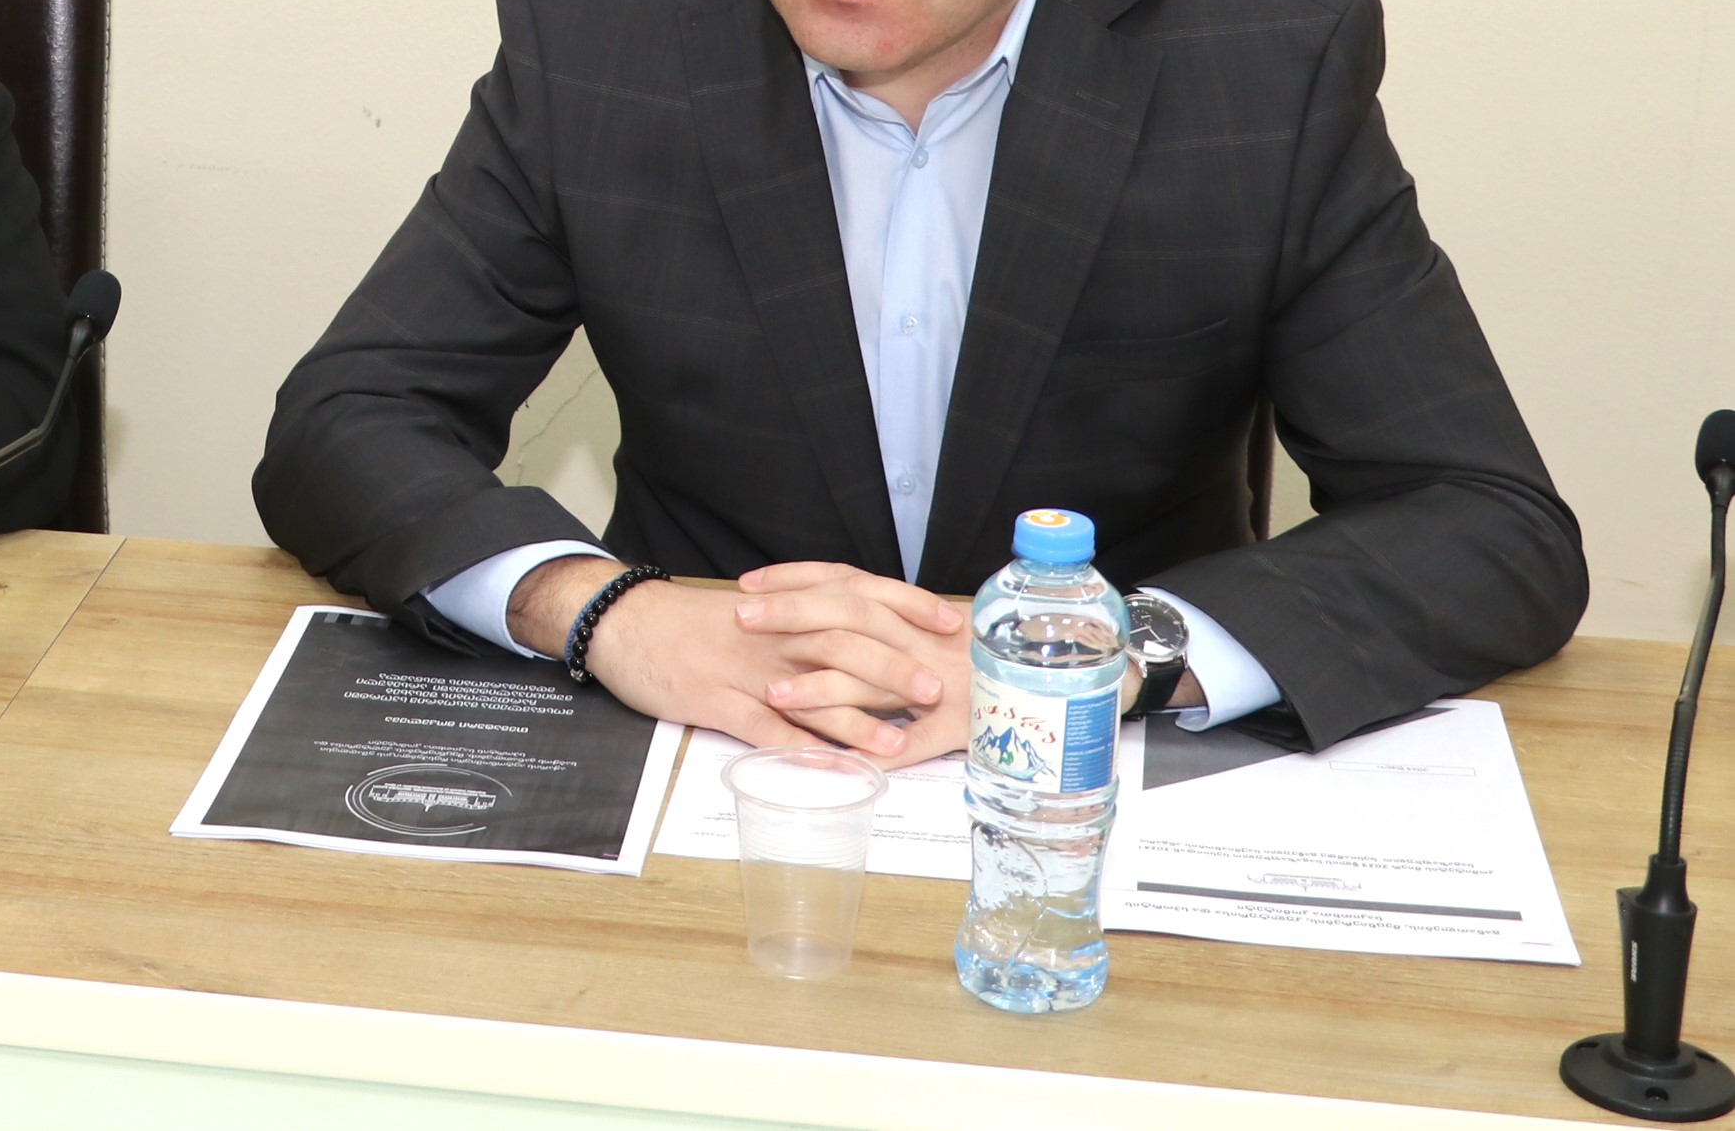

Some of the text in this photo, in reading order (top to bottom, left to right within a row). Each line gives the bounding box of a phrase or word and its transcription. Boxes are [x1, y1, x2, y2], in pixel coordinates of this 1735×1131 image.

[355, 677, 427, 692] არსებული
[378, 673, 555, 693] მდგომარეობის შესწავლა
[344, 691, 574, 715] მოსწავლეთა მასობრივ სპორტში
[385, 688, 537, 705] ჩართულობის შესახებ
[384, 716, 529, 734] თემატური მოკვლევა
